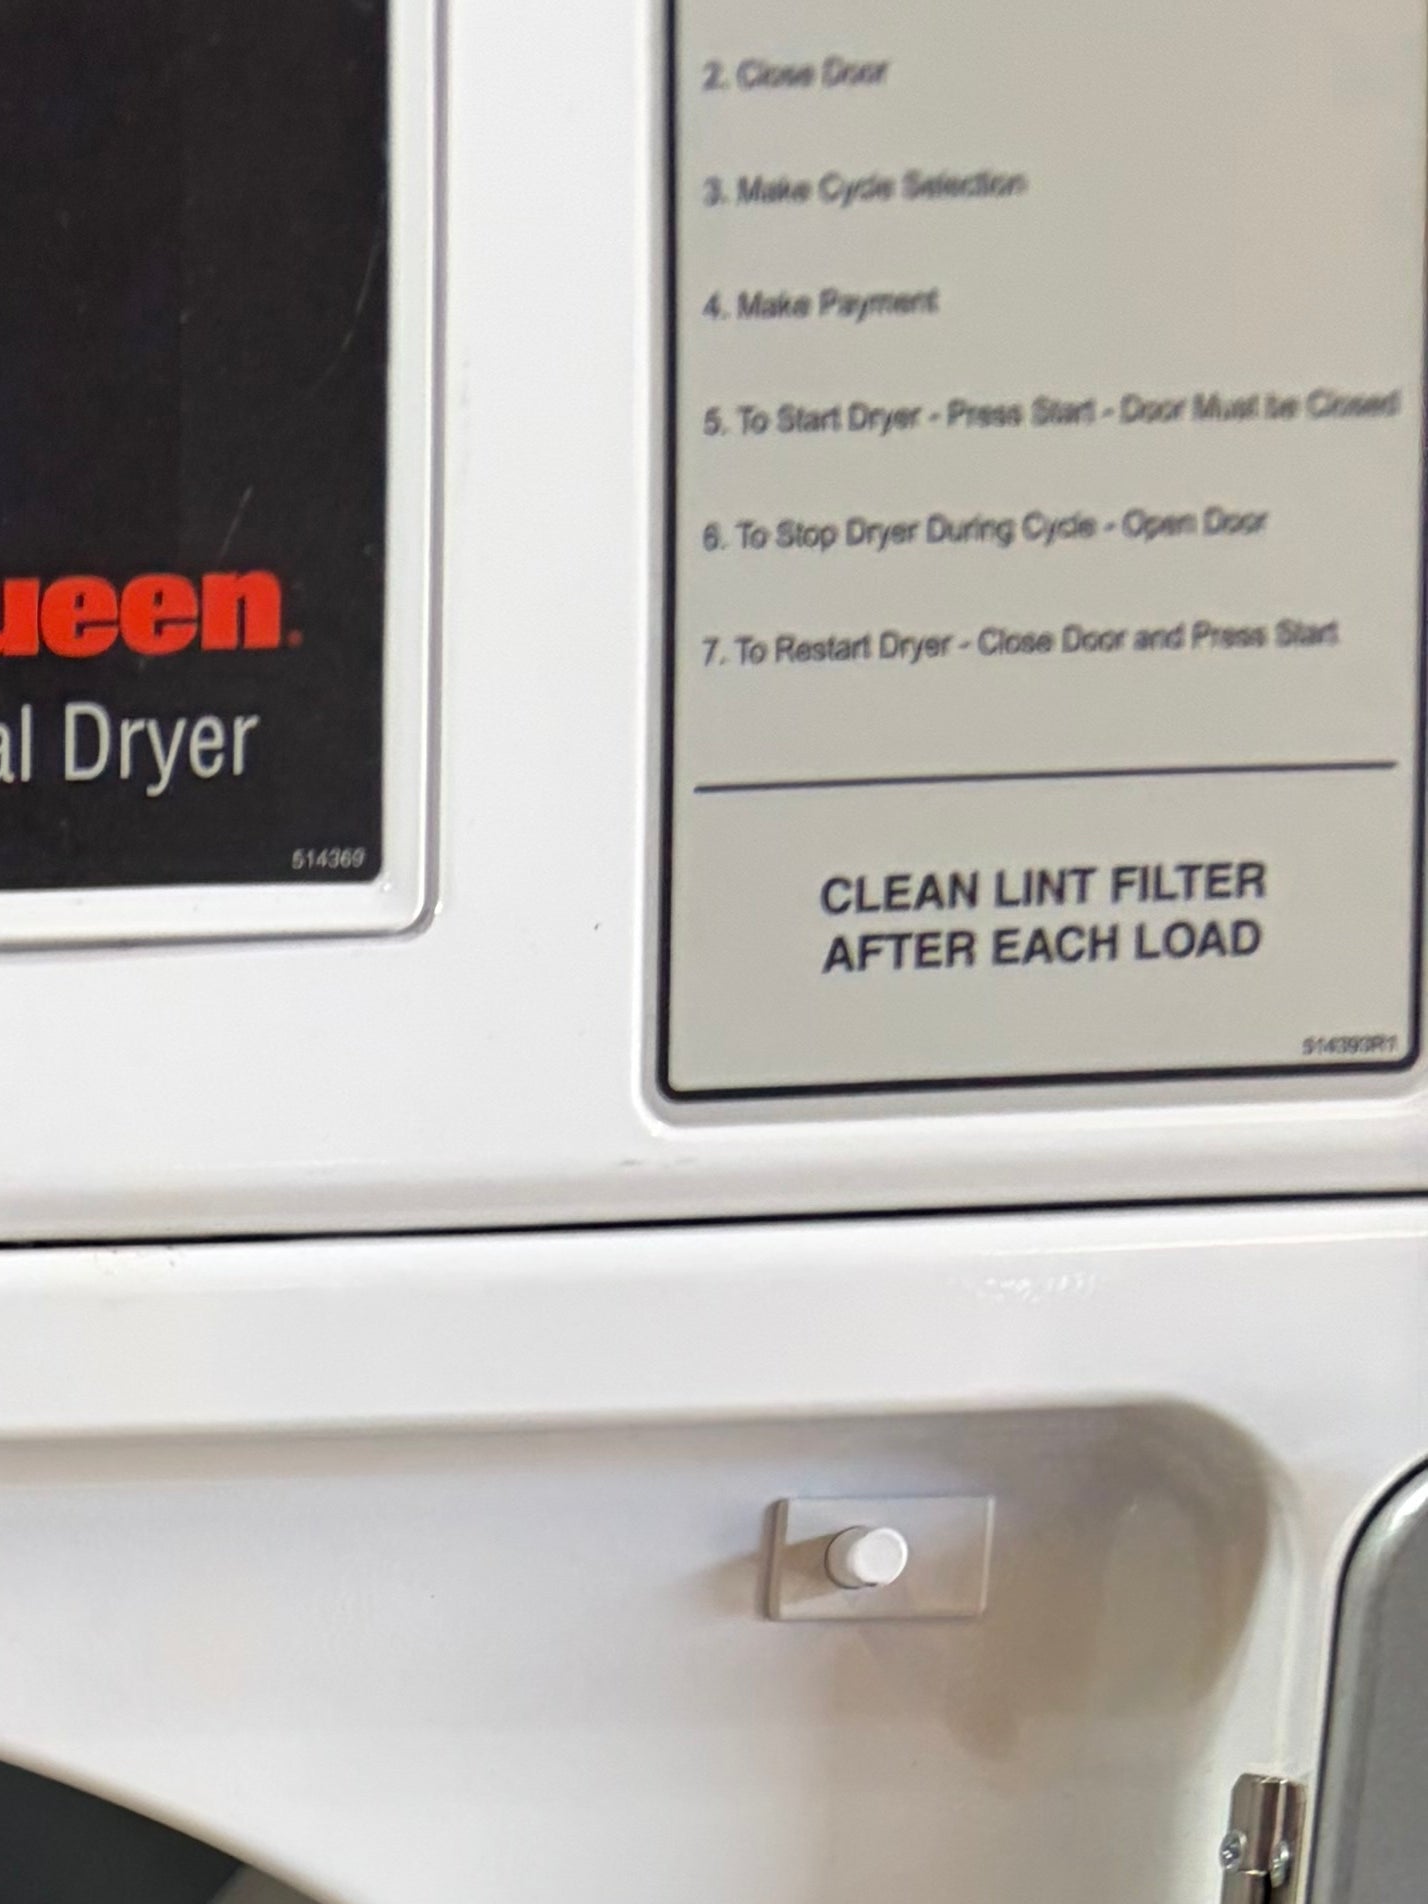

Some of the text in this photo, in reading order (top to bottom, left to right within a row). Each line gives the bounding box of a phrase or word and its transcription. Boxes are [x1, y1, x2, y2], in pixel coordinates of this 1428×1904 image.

[736, 57, 815, 91] Close
[821, 53, 890, 88] Door
[737, 289, 812, 320] Make
[819, 286, 940, 325] Payment
[702, 505, 1269, 552] 6. To Stop Dryer During Cycle Open Door
[702, 617, 1339, 668] 7. To Restart Dryer Close Door and Press Start
[63, 700, 260, 798] Dryer
[821, 861, 1266, 915] CLEAN LINT FILTER
[822, 919, 1262, 974] AFTER EACH LOAD
